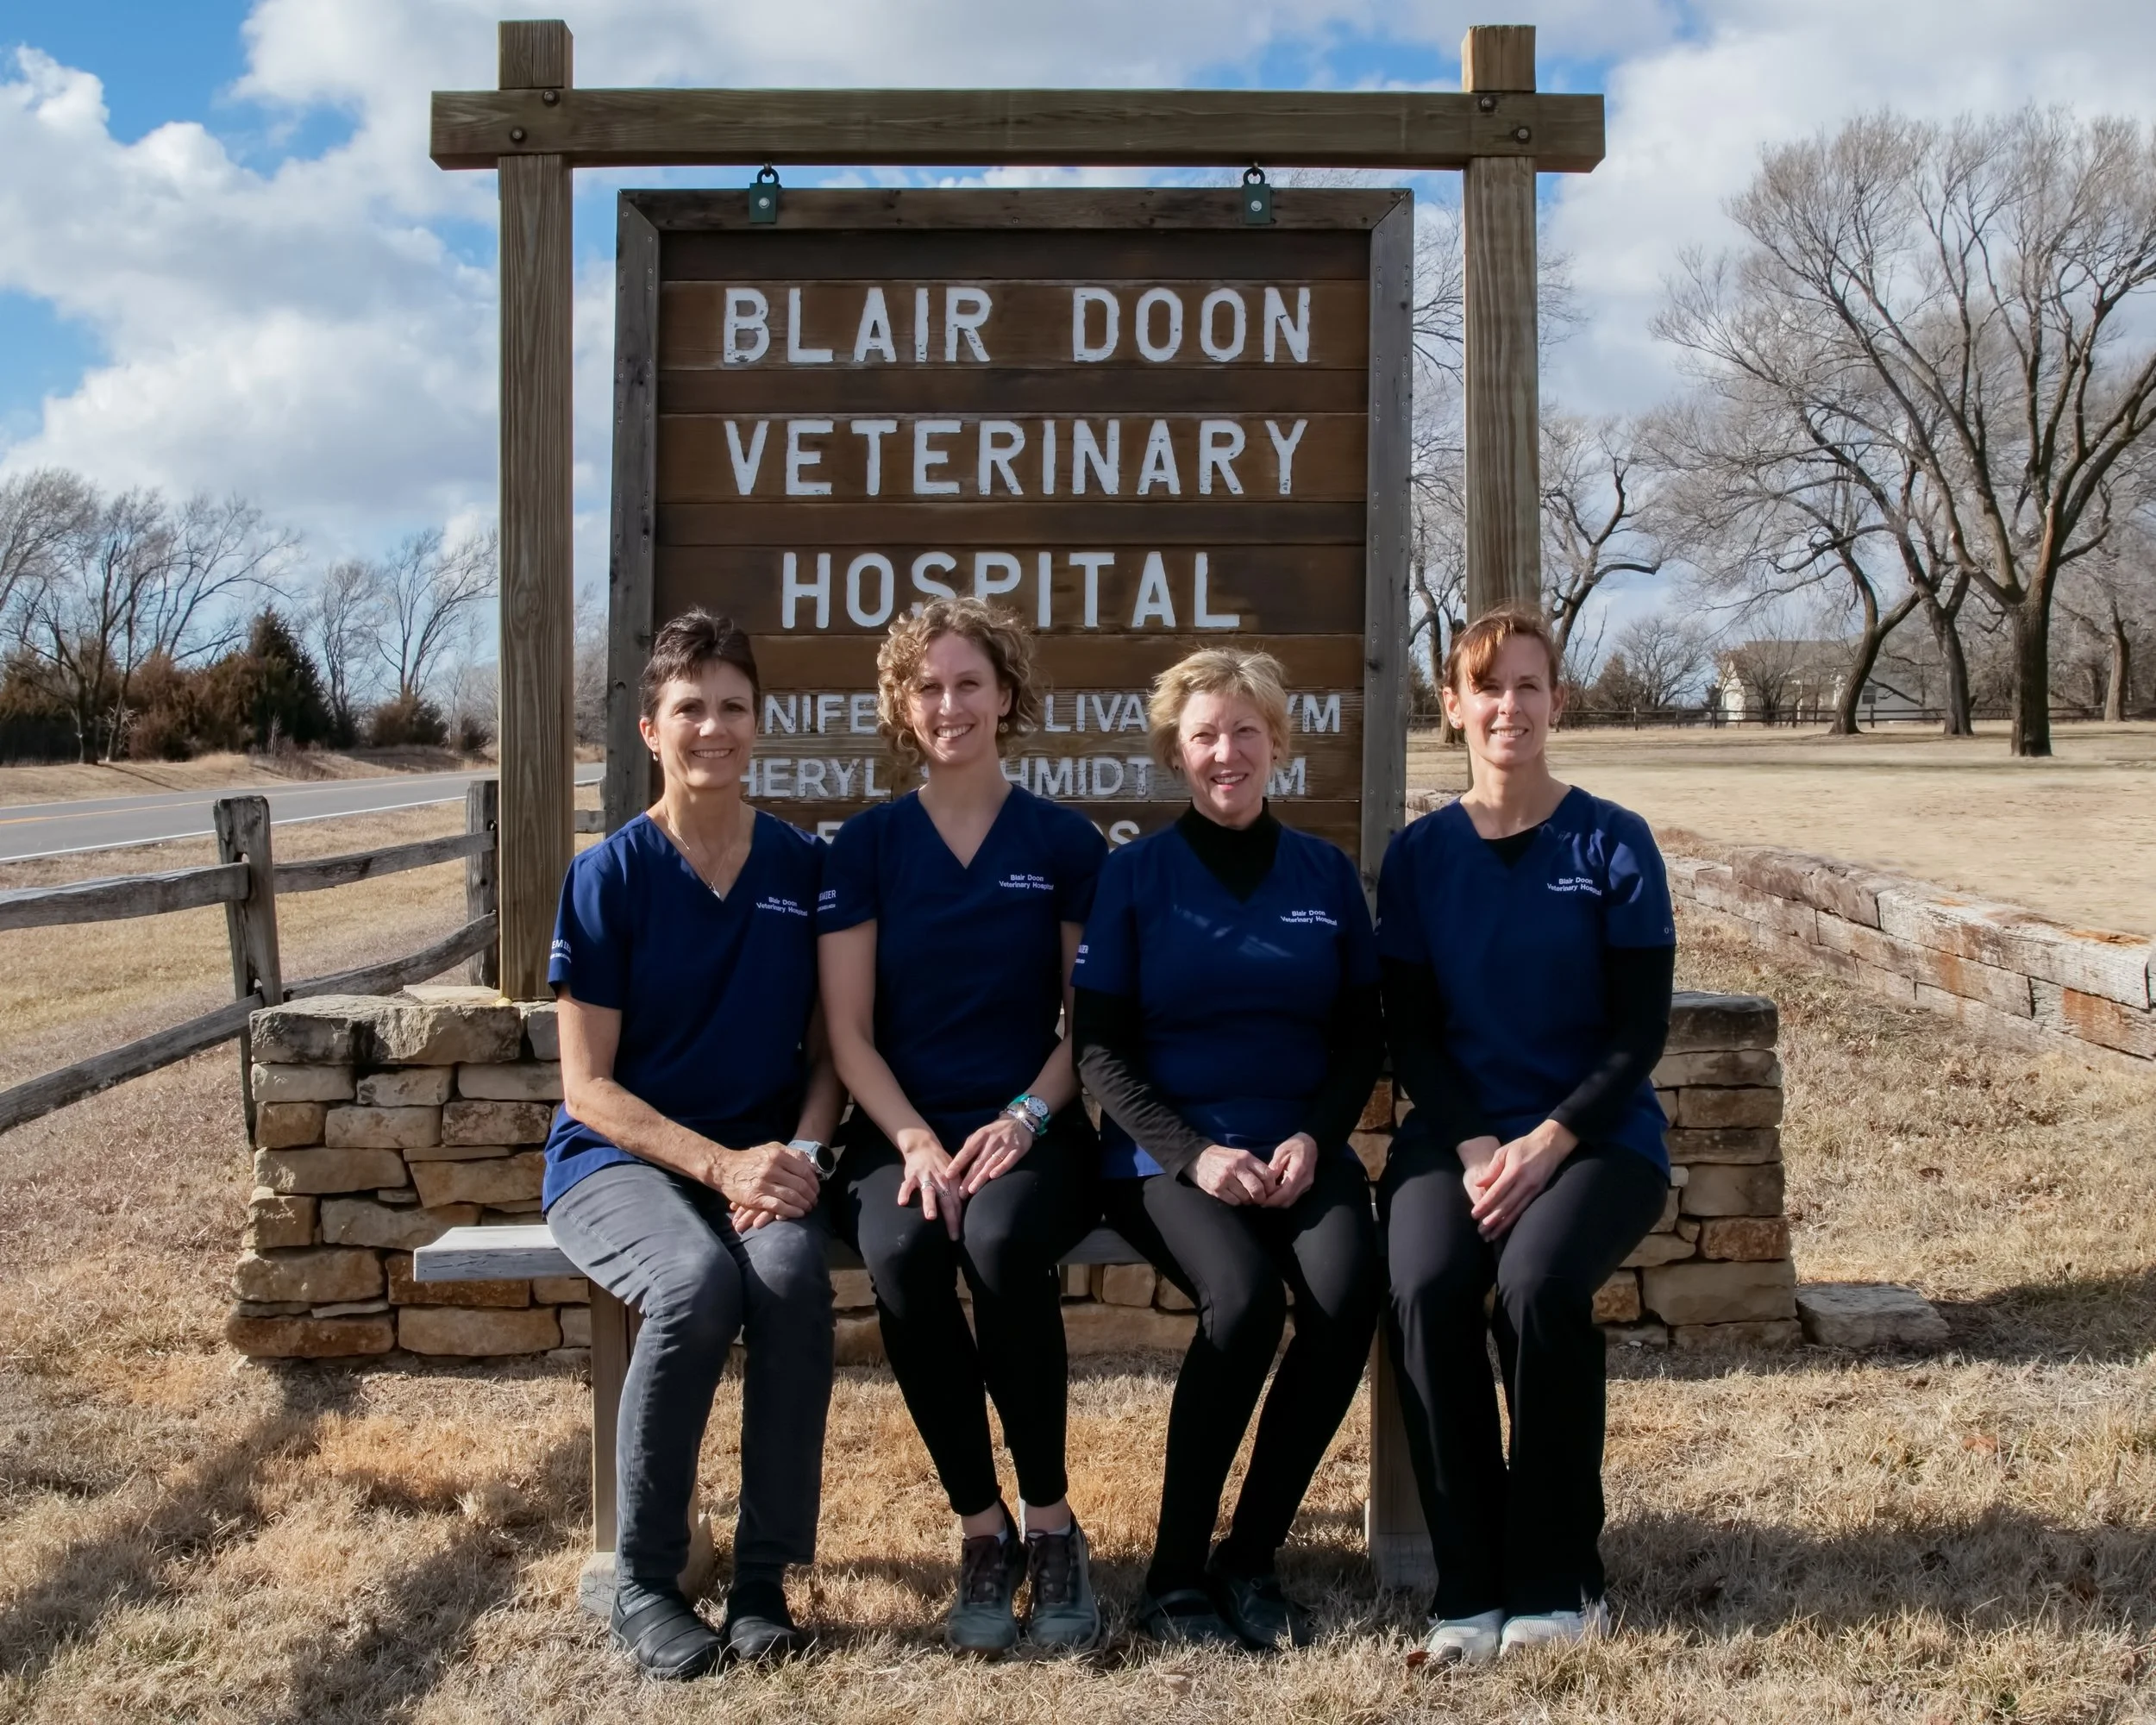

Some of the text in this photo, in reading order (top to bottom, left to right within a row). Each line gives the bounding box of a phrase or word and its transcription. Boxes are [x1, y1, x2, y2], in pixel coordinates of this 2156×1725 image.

[723, 287, 1311, 364] BLAIR DOON
[724, 419, 1309, 495] VETERINARY
[780, 551, 1241, 630] HOSPITAL
[765, 693, 1149, 735] NIFE LIVA
[739, 757, 892, 798] HERYL
[999, 881, 1031, 889] Veterinary
[1546, 882, 1578, 892] Veterinary
[1576, 876, 1594, 885] Doon
[1280, 915, 1313, 924] Veterinary
